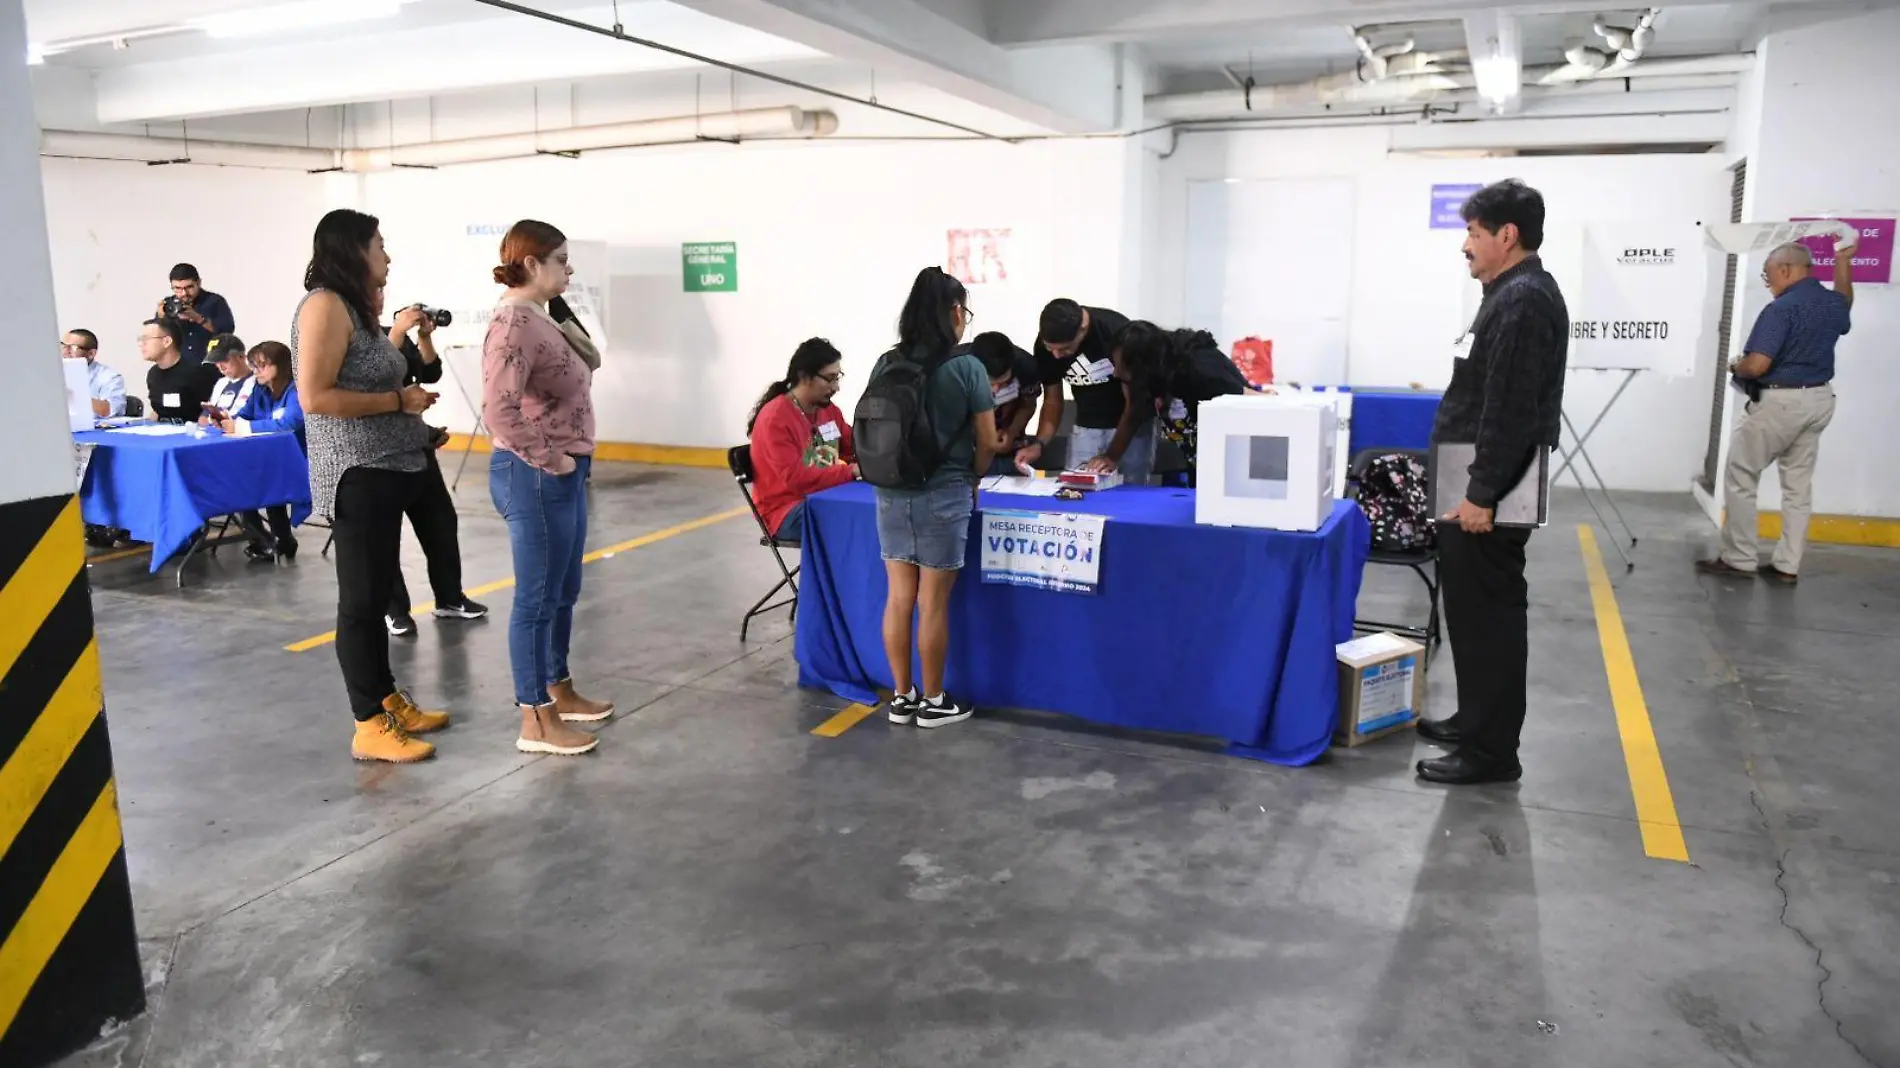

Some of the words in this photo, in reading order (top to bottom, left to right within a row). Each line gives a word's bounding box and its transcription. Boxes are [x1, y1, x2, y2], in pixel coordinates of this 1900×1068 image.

[466, 223, 511, 236] EXCLU
[1862, 228, 1880, 238] DE
[688, 254, 727, 264] GENERAL
[1624, 248, 1675, 257] OPLE
[700, 273, 725, 286] UNO
[1570, 321, 1597, 339] IBRE
[1602, 321, 1609, 339] Y
[1613, 321, 1668, 339] SECRETO
[989, 521, 1016, 532] MESA
[1018, 523, 1078, 539] RECEPTORA
[988, 536, 1093, 563] VOTACIÓN
